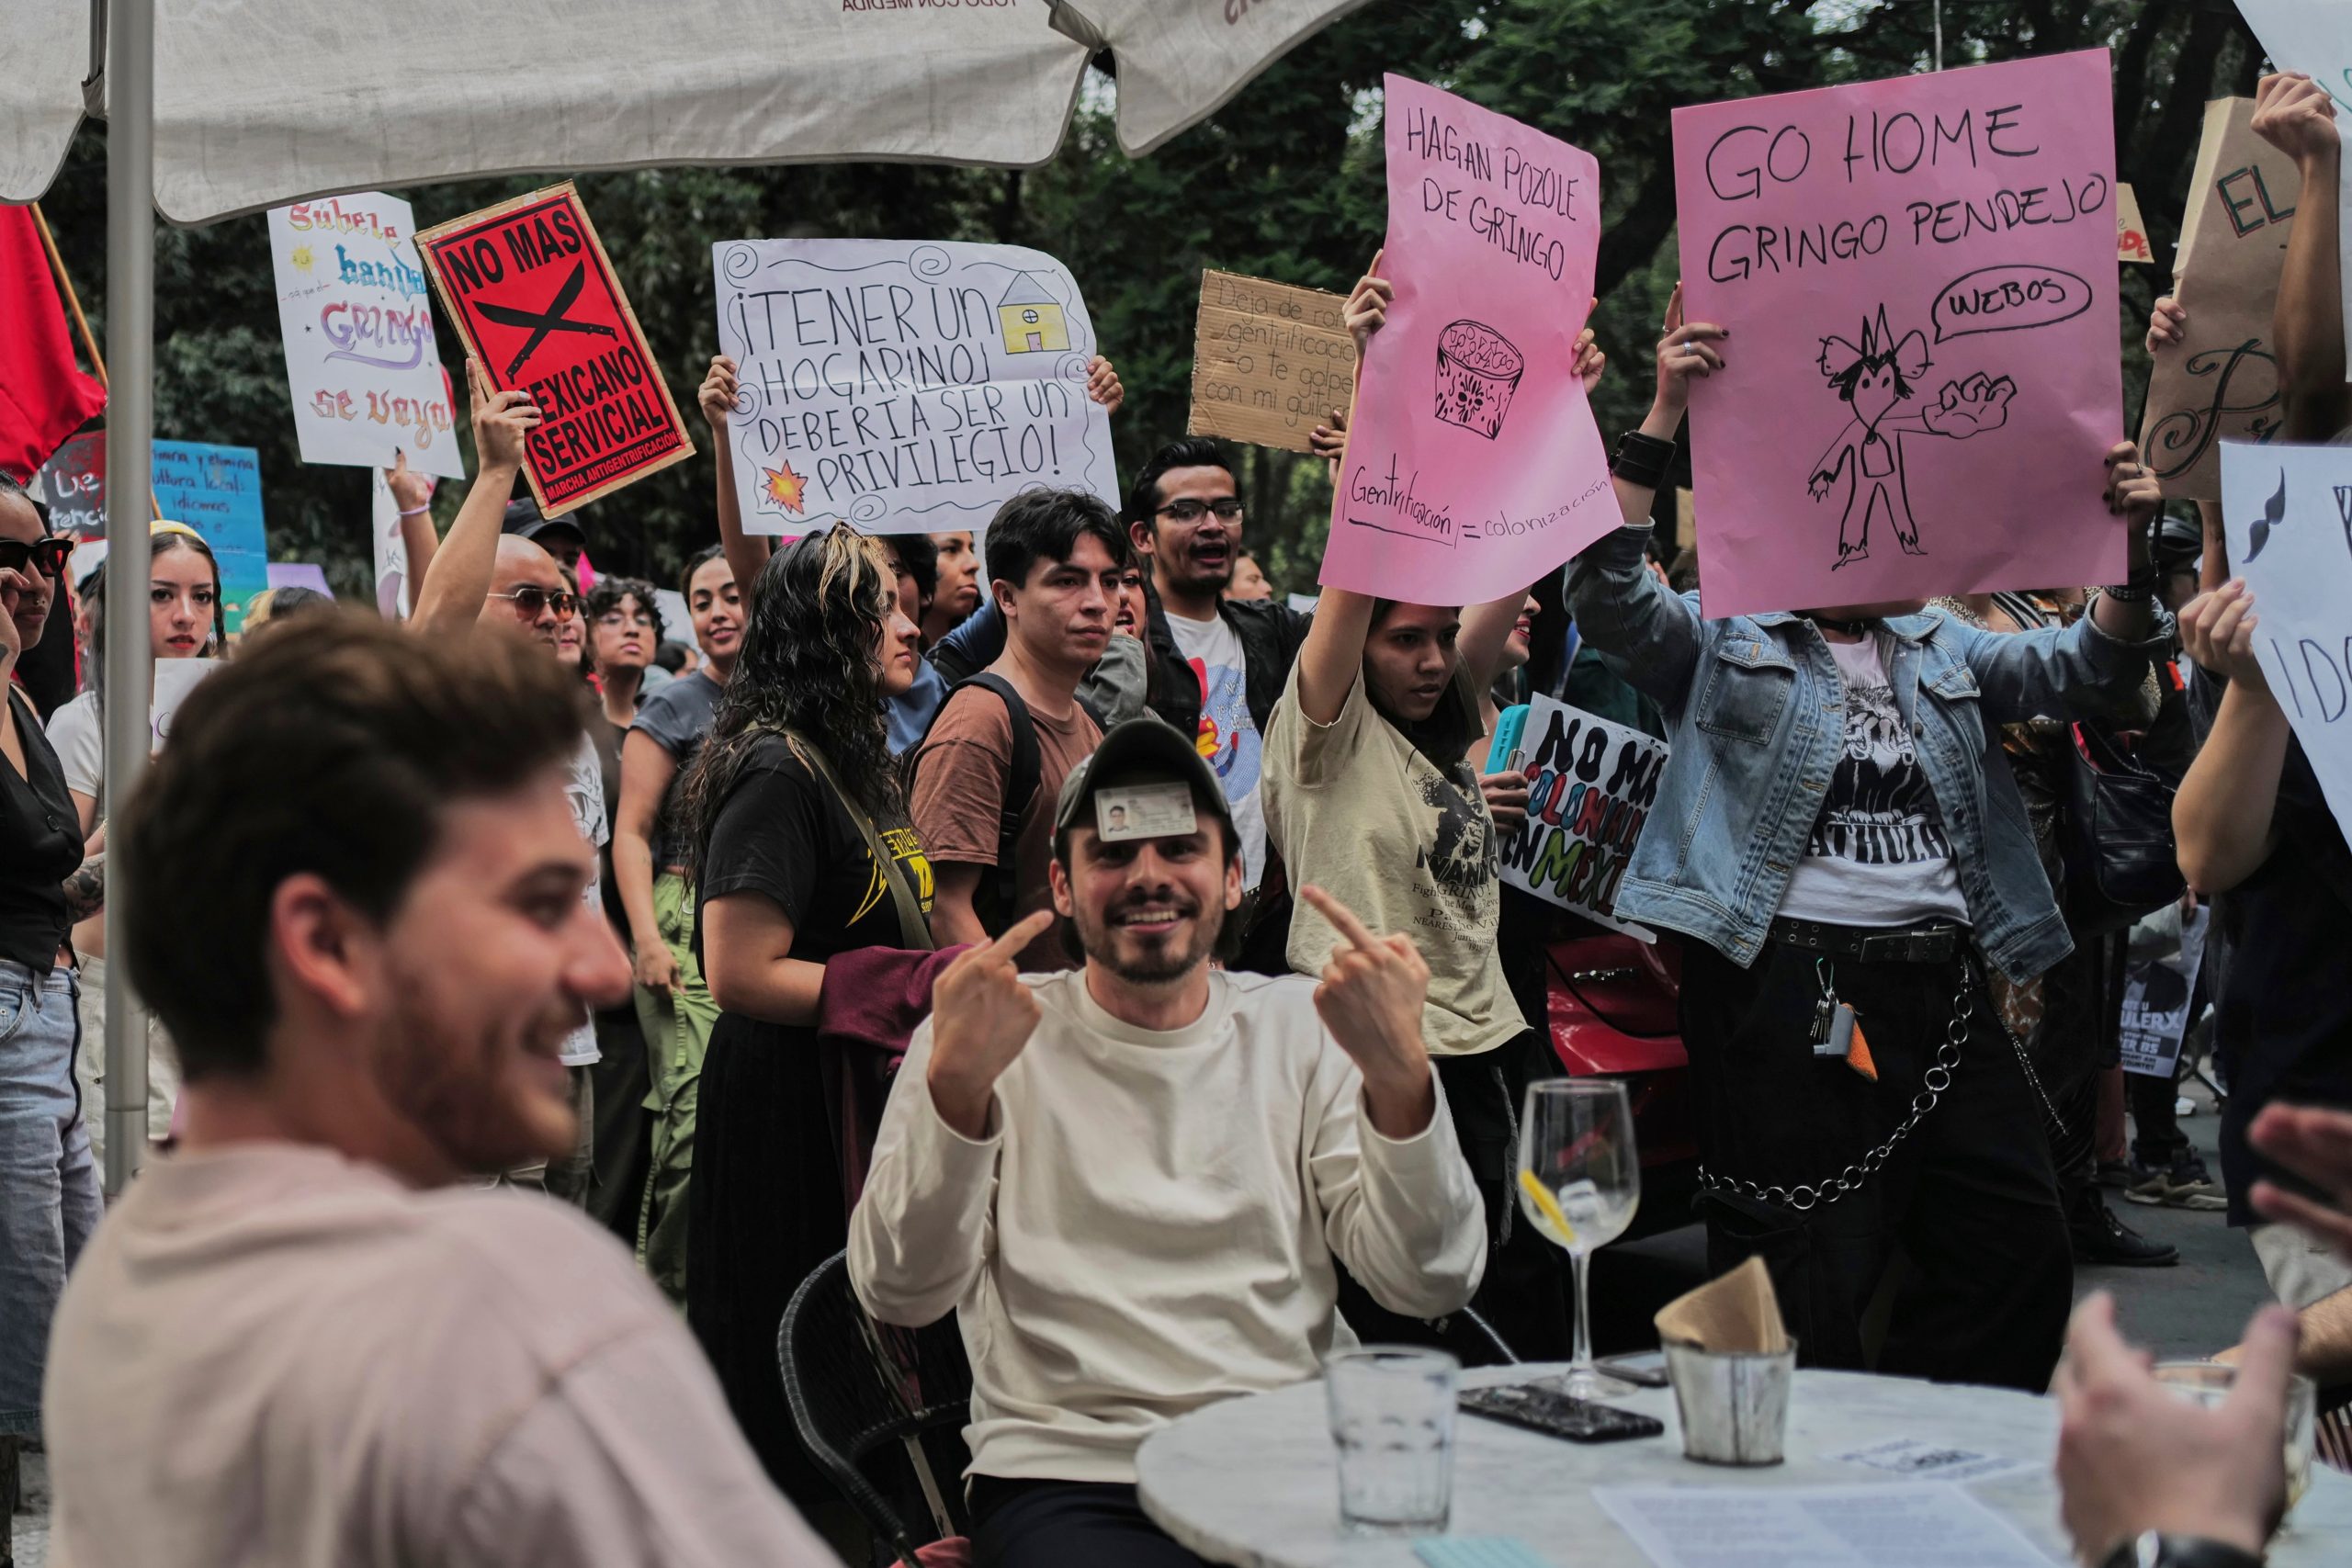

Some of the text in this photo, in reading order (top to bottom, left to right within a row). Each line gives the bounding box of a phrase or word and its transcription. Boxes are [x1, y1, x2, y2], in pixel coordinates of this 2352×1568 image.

[1408, 107, 1579, 221] HAGAN POZOLE
[1706, 104, 2040, 201] GO HOME
[1424, 177, 1565, 281] DE GRINGO
[1708, 173, 2108, 283] GRINGO PENDEJO
[2216, 164, 2297, 239] EL
[445, 209, 582, 295] NO MÁS
[737, 284, 920, 355] ¡TENER
[1217, 278, 1269, 325] Deja
[1278, 291, 1303, 321] de
[1949, 277, 2067, 315] WEBOS
[510, 344, 643, 432] EXICANO
[1204, 382, 1242, 403] con
[1253, 388, 1278, 410] mi
[1268, 347, 1288, 380] te
[309, 389, 450, 450] se vaya
[532, 389, 665, 475] SERVICIAL
[941, 386, 1006, 432] SER
[546, 432, 679, 501] MARCHA ANTIGENTRIFICACIÓN
[817, 423, 1060, 502] PRIVILEGIO!
[1351, 453, 1451, 535] Gentrificación
[1485, 479, 1609, 537] colonización
[2270, 636, 2352, 723] ID
[1535, 709, 1668, 808] NO MA
[1412, 883, 1439, 898] Figh
[1529, 829, 1629, 919] MEXI
